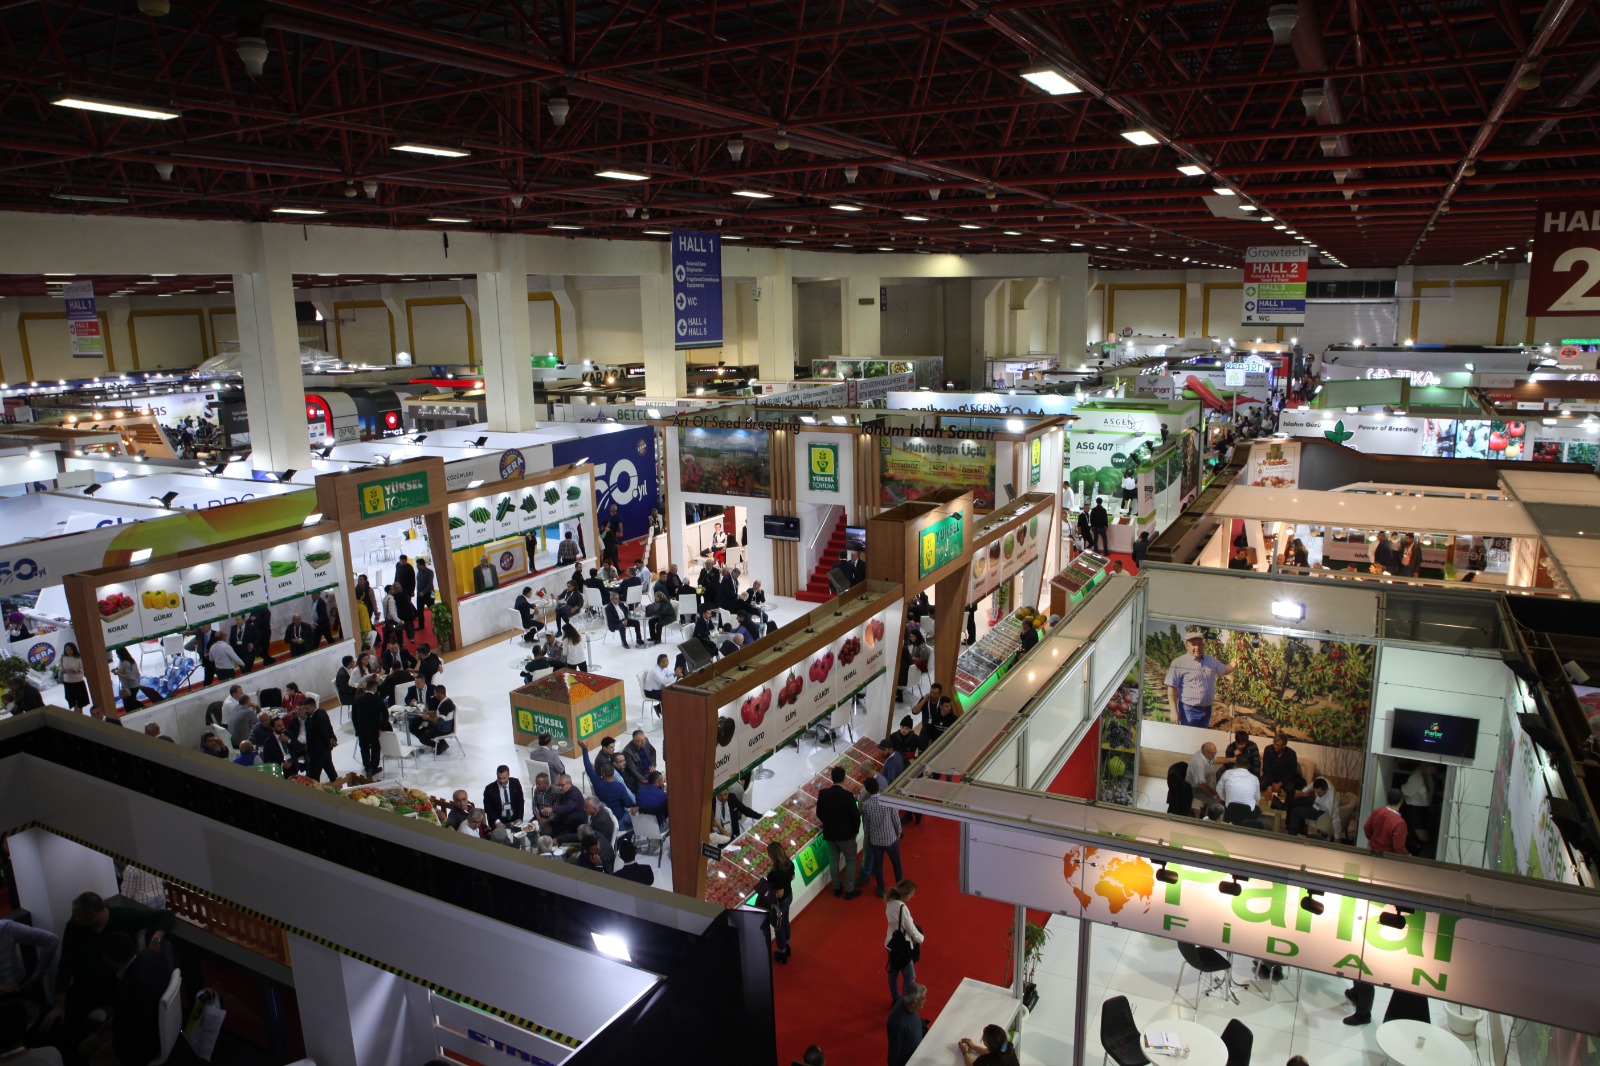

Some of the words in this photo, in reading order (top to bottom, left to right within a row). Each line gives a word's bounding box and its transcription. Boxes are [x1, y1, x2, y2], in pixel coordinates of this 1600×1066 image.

[679, 236, 706, 252] HALL
[709, 238, 714, 253] 1
[1247, 246, 1305, 258] Growtech
[1253, 263, 1287, 273] HALL
[1291, 263, 1299, 273] 2
[1546, 247, 1600, 311] 2
[69, 300, 87, 310] HALL
[687, 297, 698, 306] WC
[688, 318, 703, 326] HALL
[689, 328, 703, 336] HALL
[672, 415, 688, 427] Art
[692, 415, 709, 428] Of
[712, 416, 741, 429] Seed
[745, 418, 801, 435] Breeding
[1388, 425, 1419, 434] Breeding
[910, 423, 943, 438] Islah
[948, 424, 994, 442] Sanatı
[965, 440, 990, 458] Üçlü
[1076, 442, 1095, 451] ASG
[1097, 443, 1114, 451] 407
[502, 457, 524, 479] SERA
[812, 475, 835, 484] YÜKSEL
[384, 479, 424, 495] YÜKSEL
[812, 482, 835, 490] TOHUM
[500, 556, 513, 565] SERA
[240, 590, 255, 599] METE
[197, 601, 216, 611] VAROL
[153, 612, 173, 623] GÜRAY
[107, 623, 129, 634] KORAY
[30, 647, 54, 663] SERA
[533, 713, 564, 729] YÜKSEL
[593, 712, 619, 731] TOHUM
[785, 709, 797, 723] ELİPS
[534, 724, 565, 739] TOHUM
[748, 731, 765, 748] GUSTO
[1162, 914, 1449, 992] FİDAN
